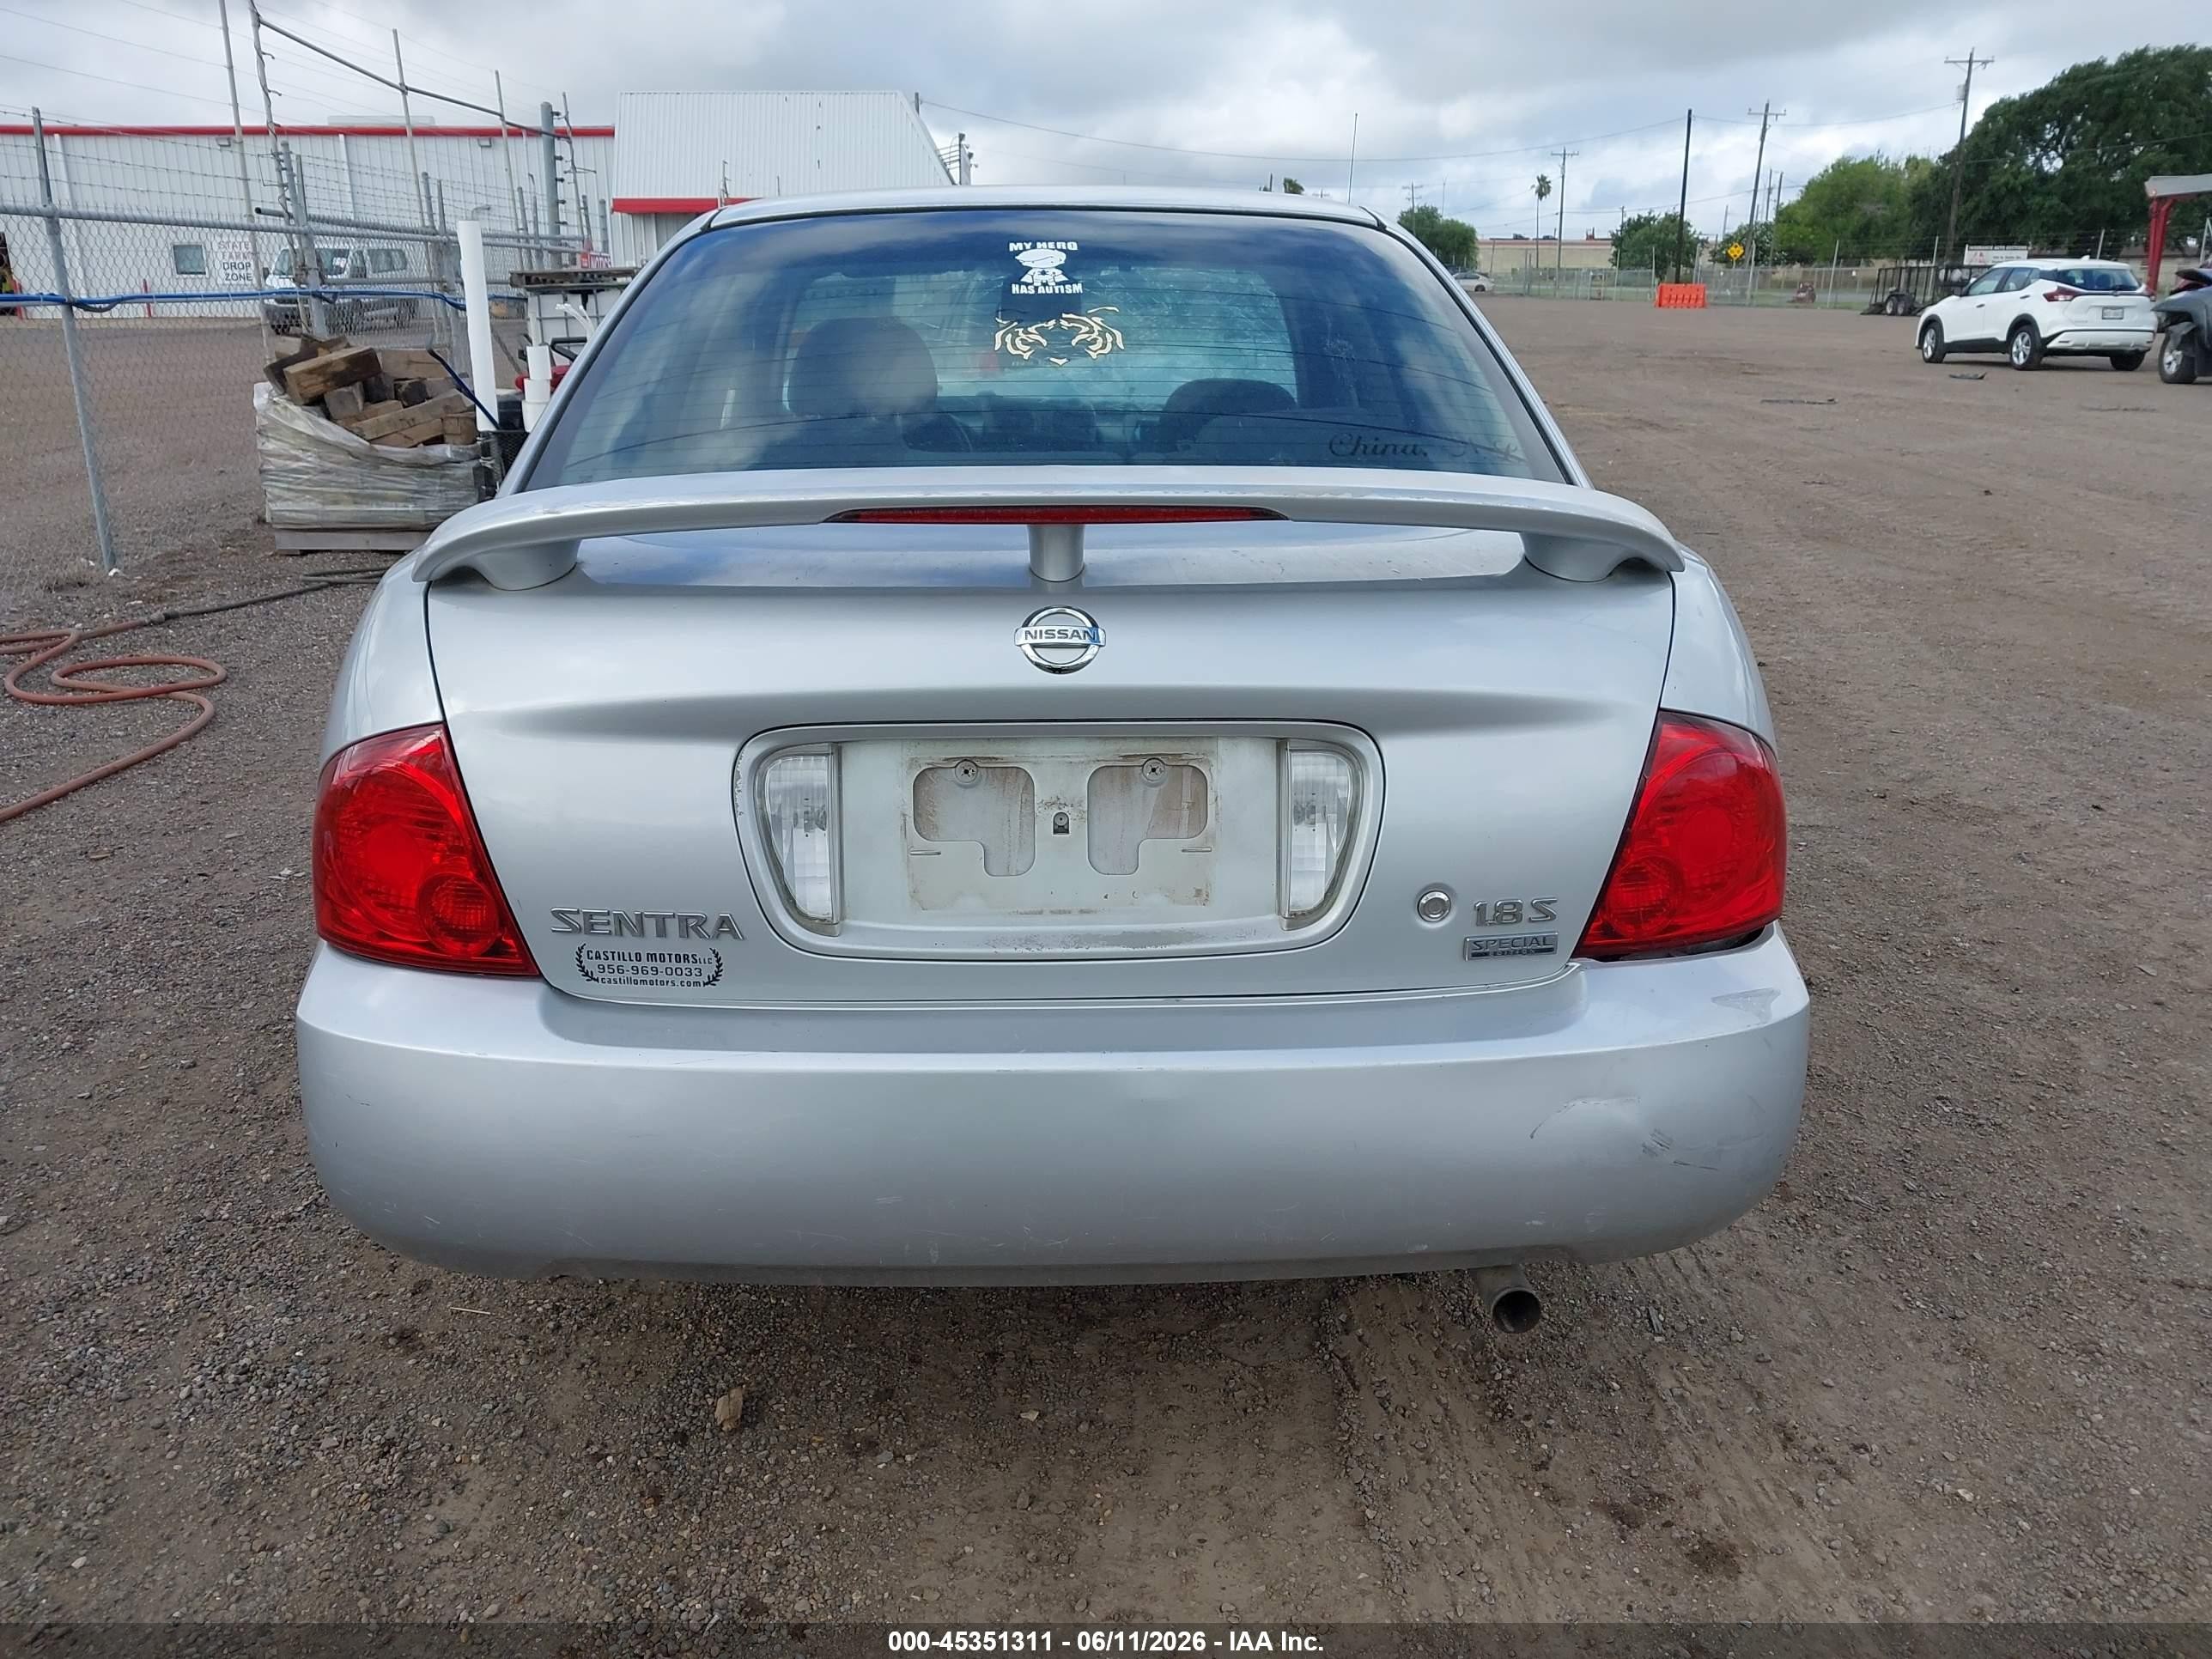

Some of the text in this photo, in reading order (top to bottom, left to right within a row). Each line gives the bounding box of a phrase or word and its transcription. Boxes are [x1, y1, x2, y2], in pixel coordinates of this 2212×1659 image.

[1009, 241, 1079, 252] MY HERO
[222, 261, 251, 270] DROP
[225, 272, 252, 282] ZONE
[1012, 283, 1083, 294] HAS AUTISM
[1024, 629, 1099, 643] NISSAN
[550, 907, 745, 940] SENTRA
[1471, 937, 1553, 951] SPECIAL
[586, 950, 642, 962] CASTILLO
[646, 952, 698, 964] MOTORS
[598, 964, 702, 976] 956-969-0033
[601, 976, 702, 988] castillomotors.com
